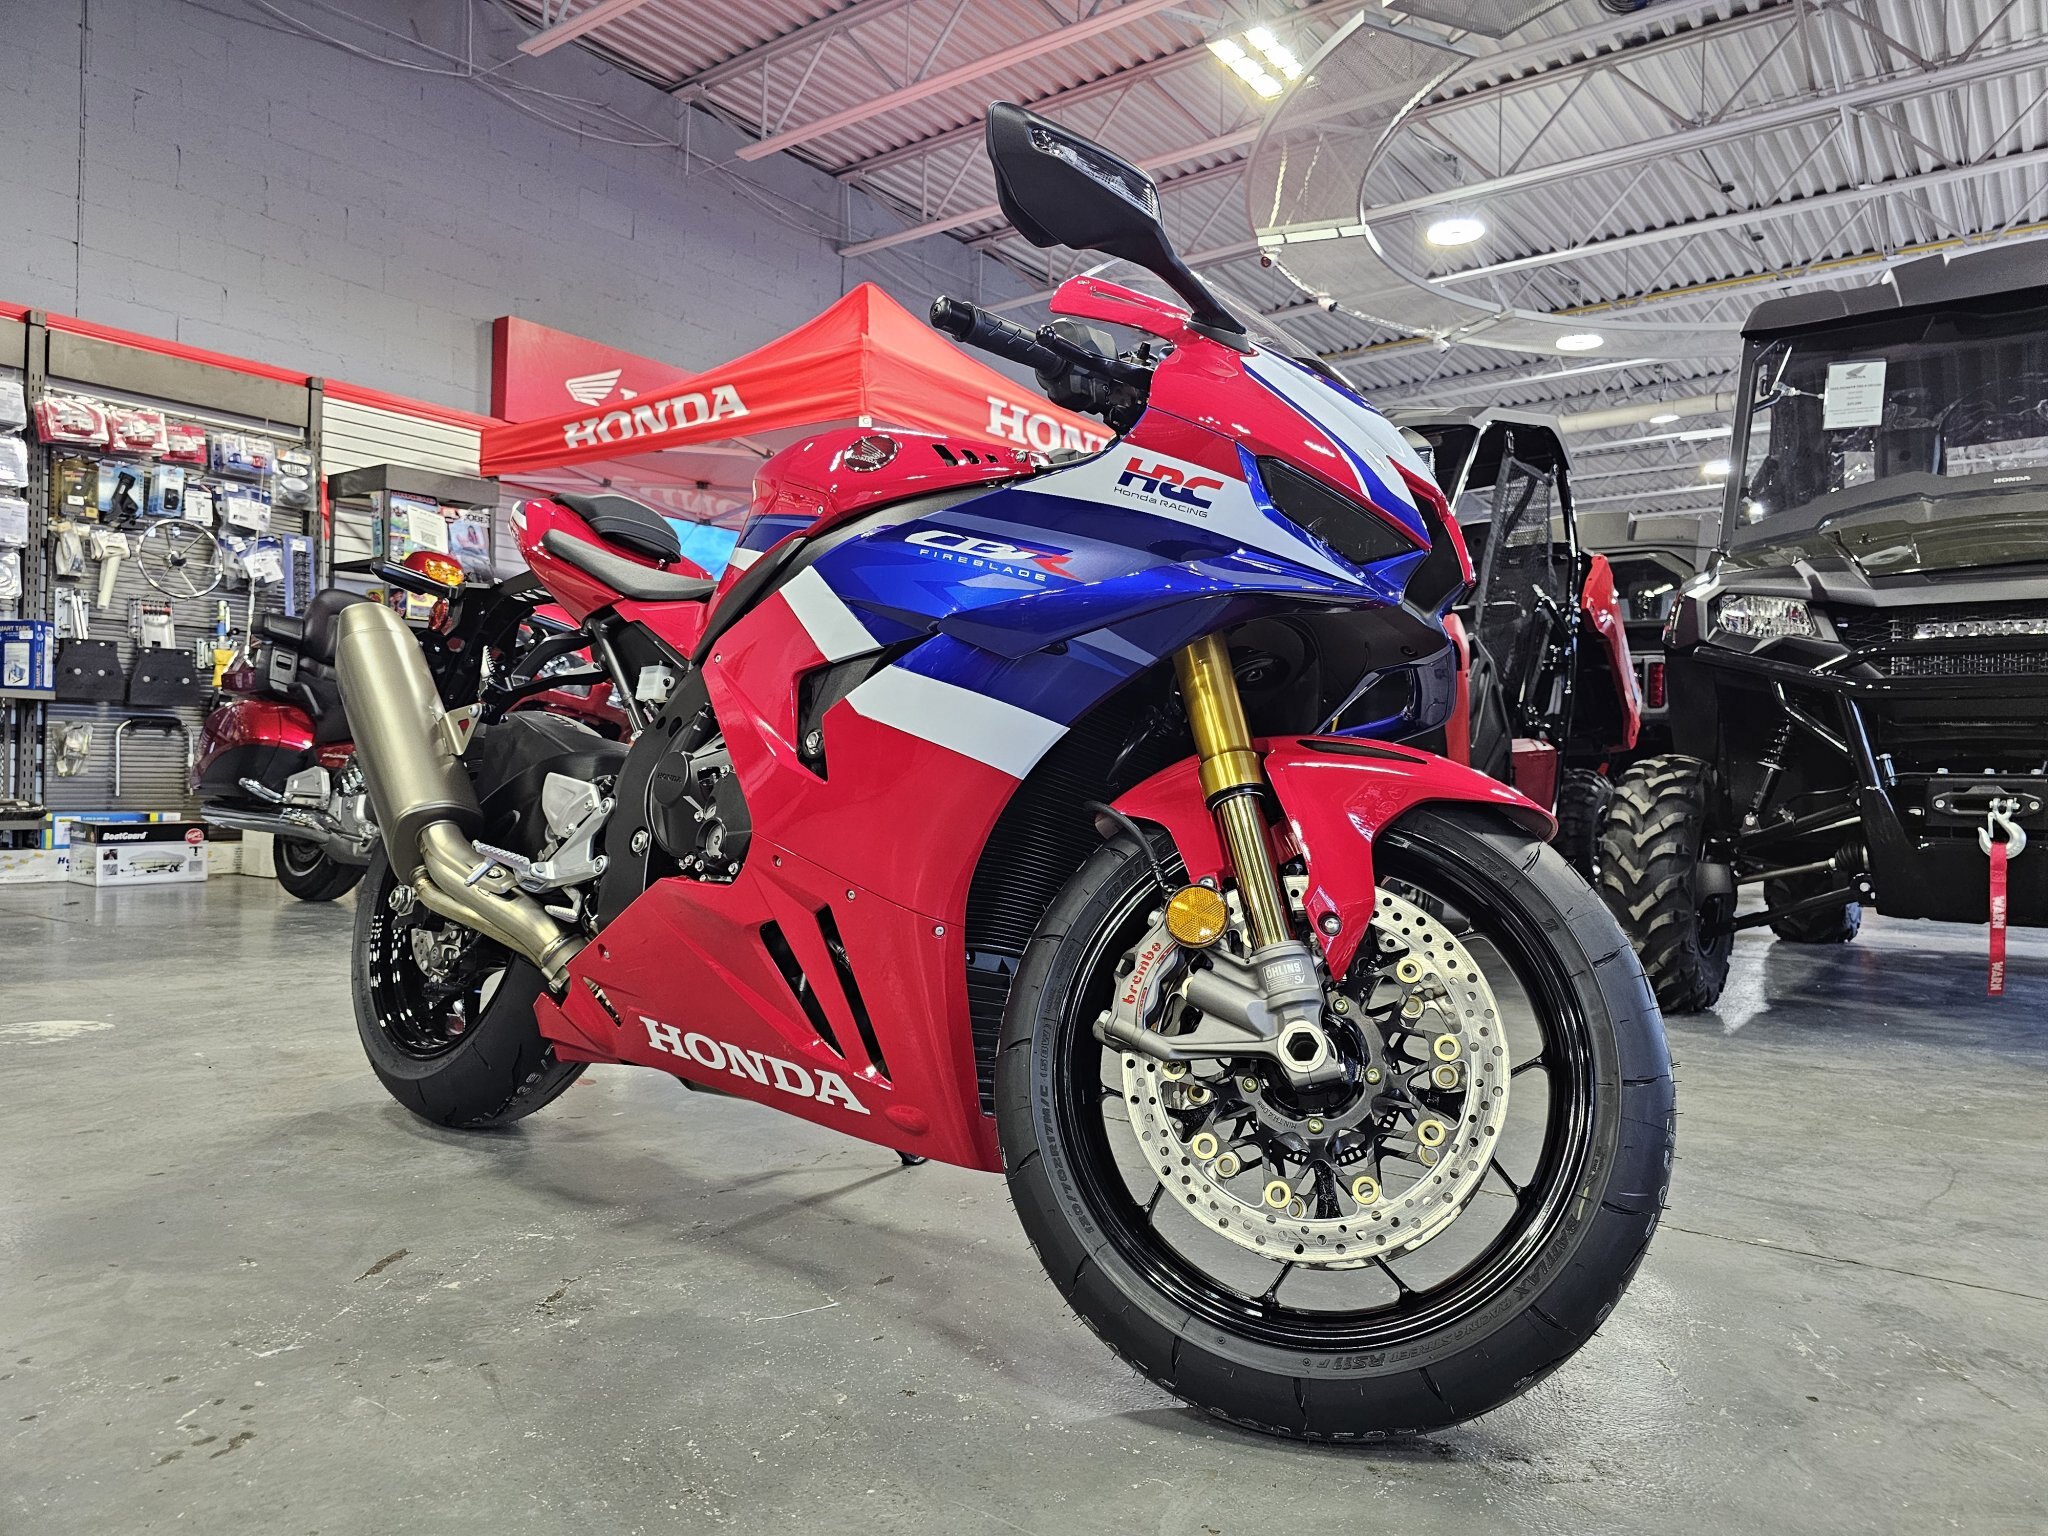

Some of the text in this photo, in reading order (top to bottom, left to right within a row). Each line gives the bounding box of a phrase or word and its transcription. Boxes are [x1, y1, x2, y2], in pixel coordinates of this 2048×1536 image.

[563, 384, 751, 449] HONDA
[1117, 456, 1225, 510] HRC
[1993, 475, 2032, 484] HONDA
[1114, 486, 1208, 519] Honda RACING
[919, 548, 1047, 582] FIREBLADE
[102, 832, 147, 841] BoatGuard
[1992, 895, 2005, 929] WARN
[1122, 942, 1162, 1005] brembo
[1990, 961, 2004, 991] WARN
[638, 1015, 871, 1115] HONDA
[1512, 1213, 1578, 1296] BATTLAX
